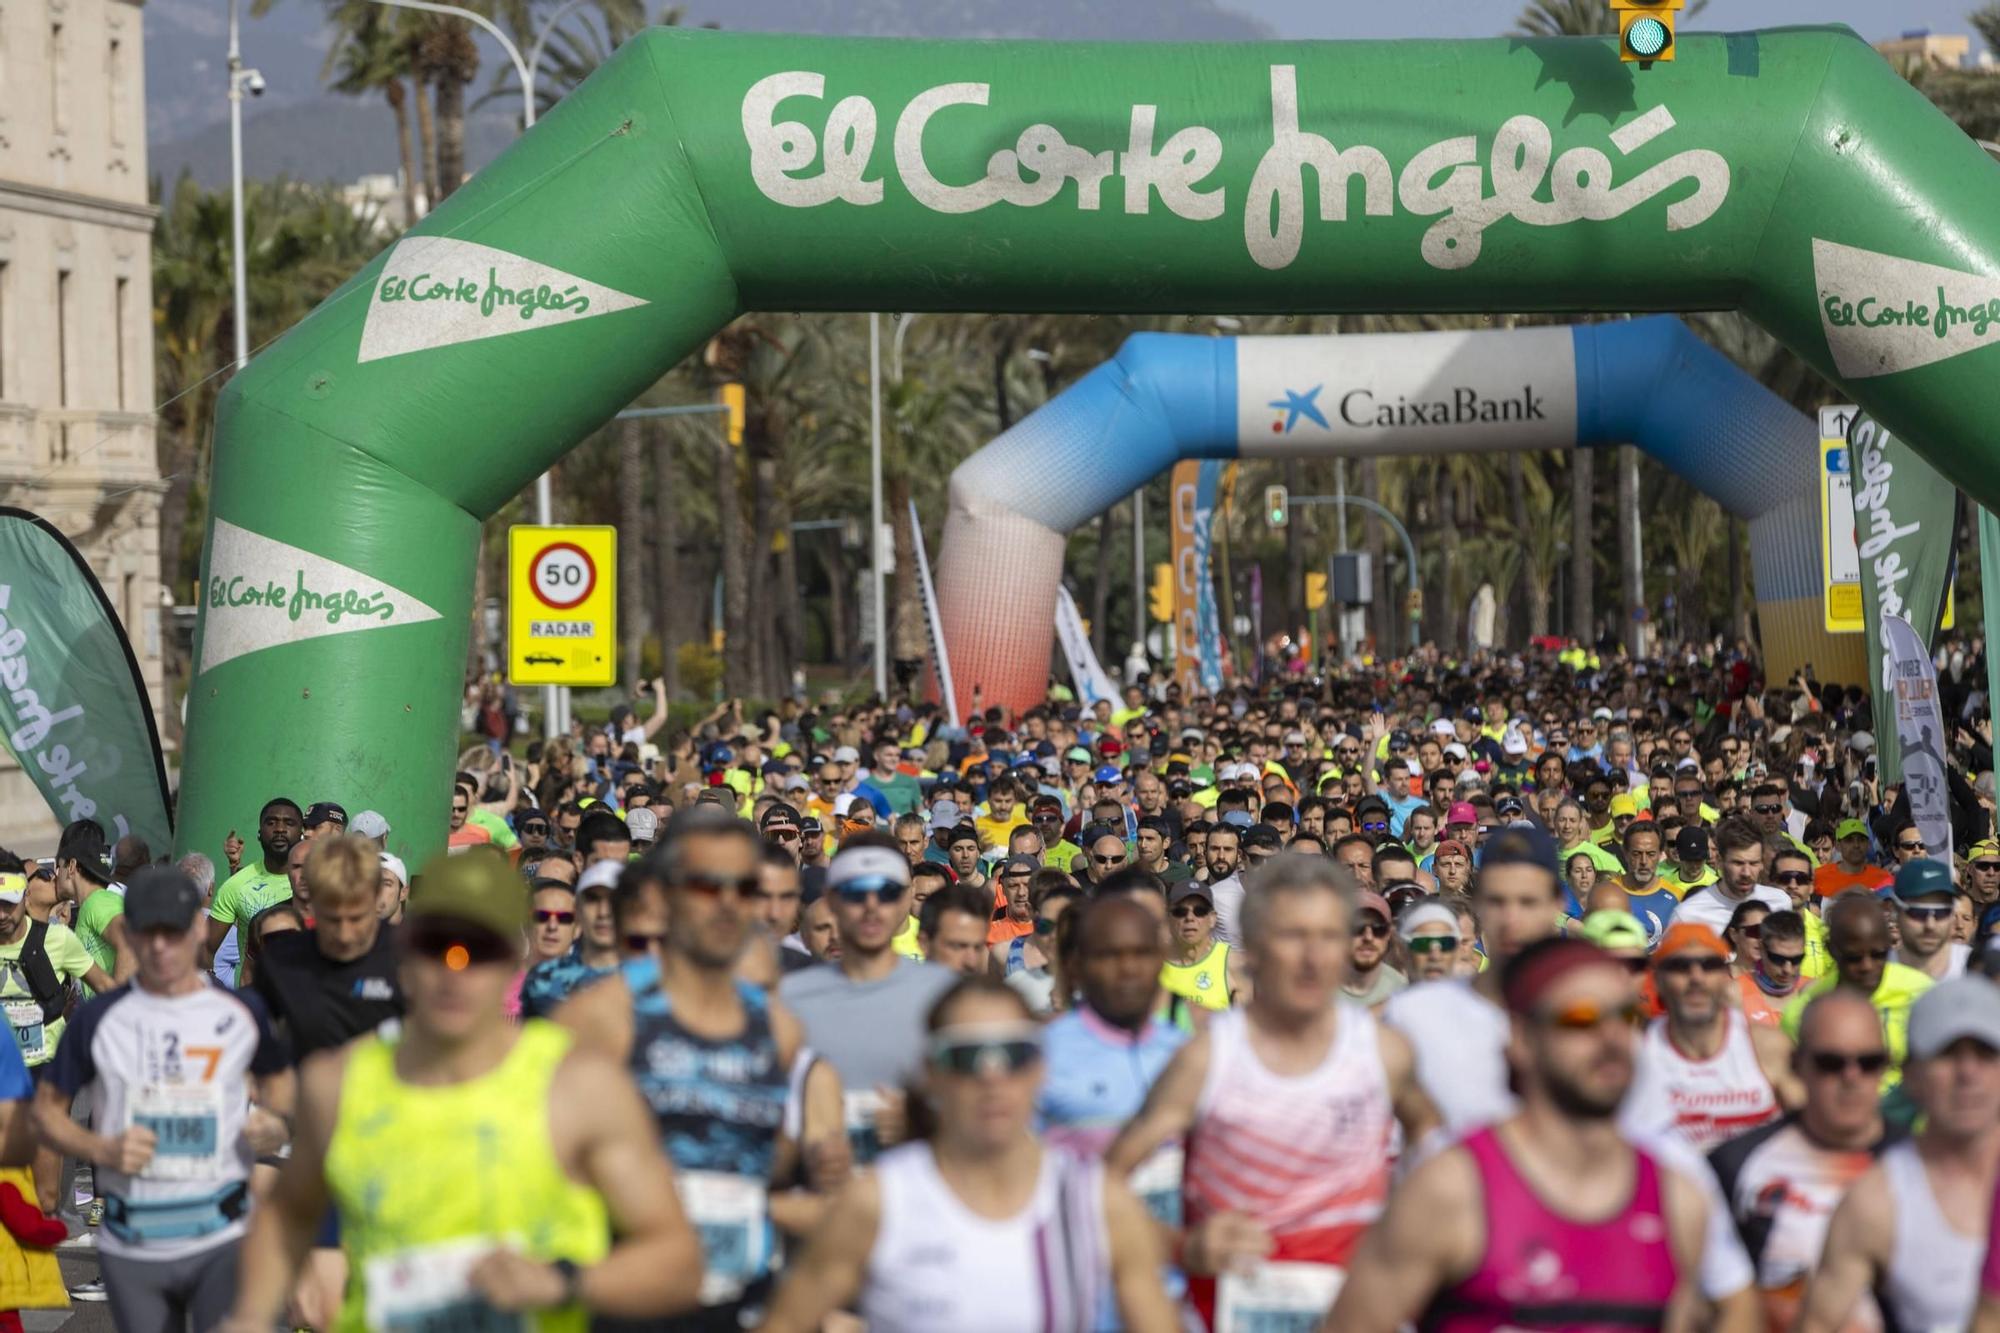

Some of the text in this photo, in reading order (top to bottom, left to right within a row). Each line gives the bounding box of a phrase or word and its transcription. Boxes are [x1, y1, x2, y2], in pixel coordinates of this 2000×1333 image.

[741, 65, 1730, 269] El Corte Inglés
[380, 267, 589, 320] El Corte Inglés
[1824, 286, 2000, 338] El Corte Ingl
[1340, 384, 1546, 428] CaixaBank
[210, 570, 394, 624] El Corte Inglés
[546, 564, 581, 586] 50
[531, 622, 592, 637] RADAR
